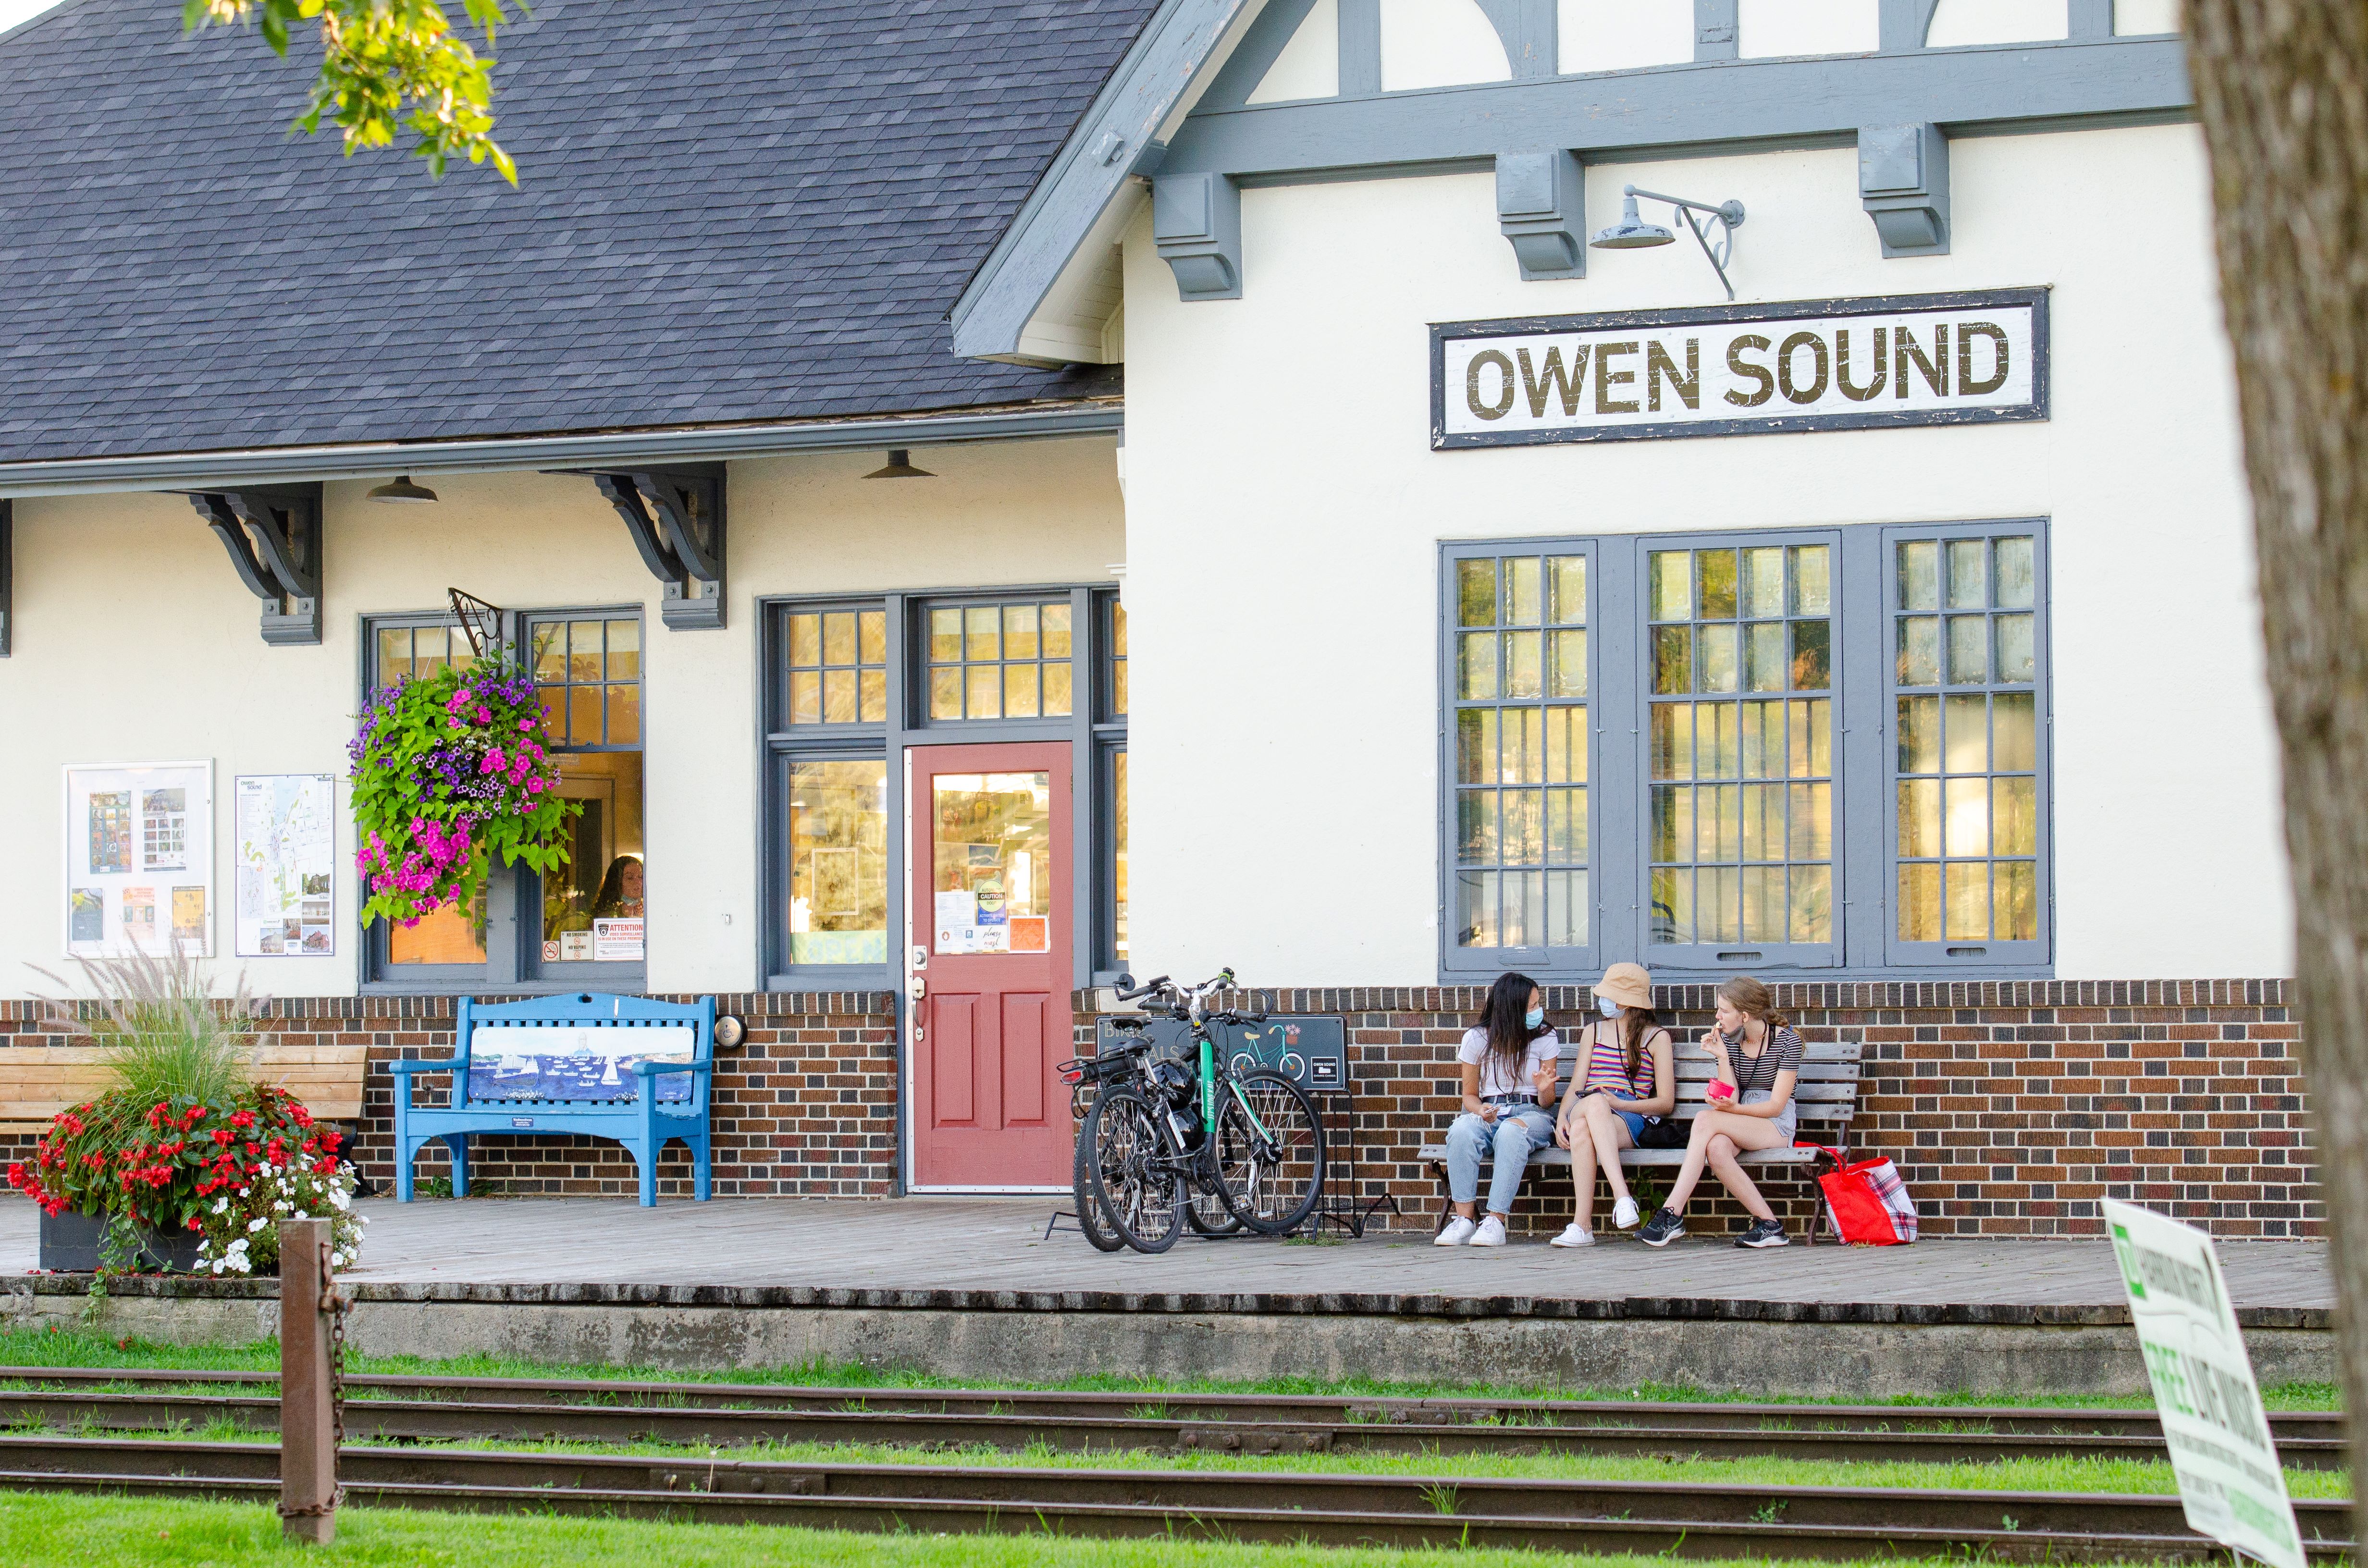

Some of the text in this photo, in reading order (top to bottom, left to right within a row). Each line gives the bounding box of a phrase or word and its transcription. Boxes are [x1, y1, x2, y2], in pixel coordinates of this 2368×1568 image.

[1466, 321, 2009, 421] OWEN SOUND
[983, 927, 1001, 938] please
[807, 937, 882, 963] OPEN
